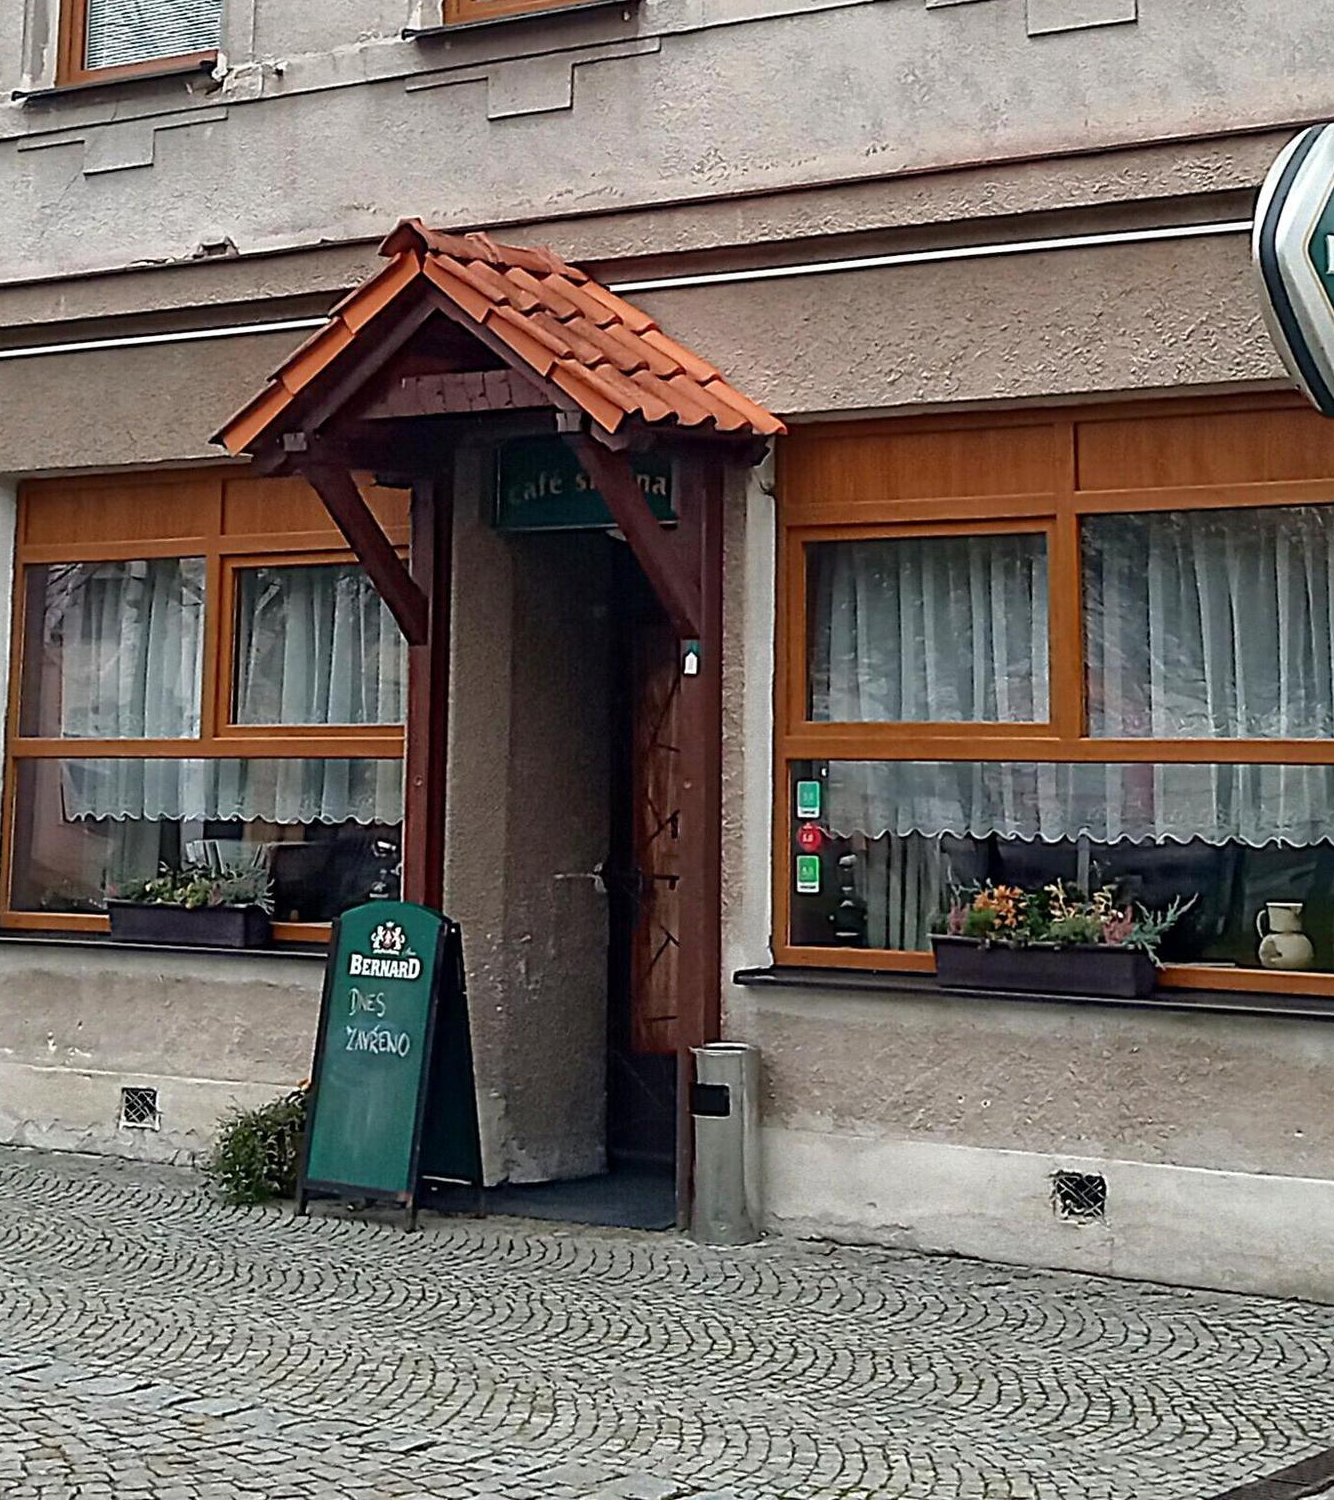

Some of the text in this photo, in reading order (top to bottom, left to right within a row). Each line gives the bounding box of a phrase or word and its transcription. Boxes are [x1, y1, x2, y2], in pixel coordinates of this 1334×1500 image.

[349, 954, 420, 979] BERNARD
[349, 988, 386, 1017] DNES
[346, 1024, 411, 1057] ZAVŘENO
